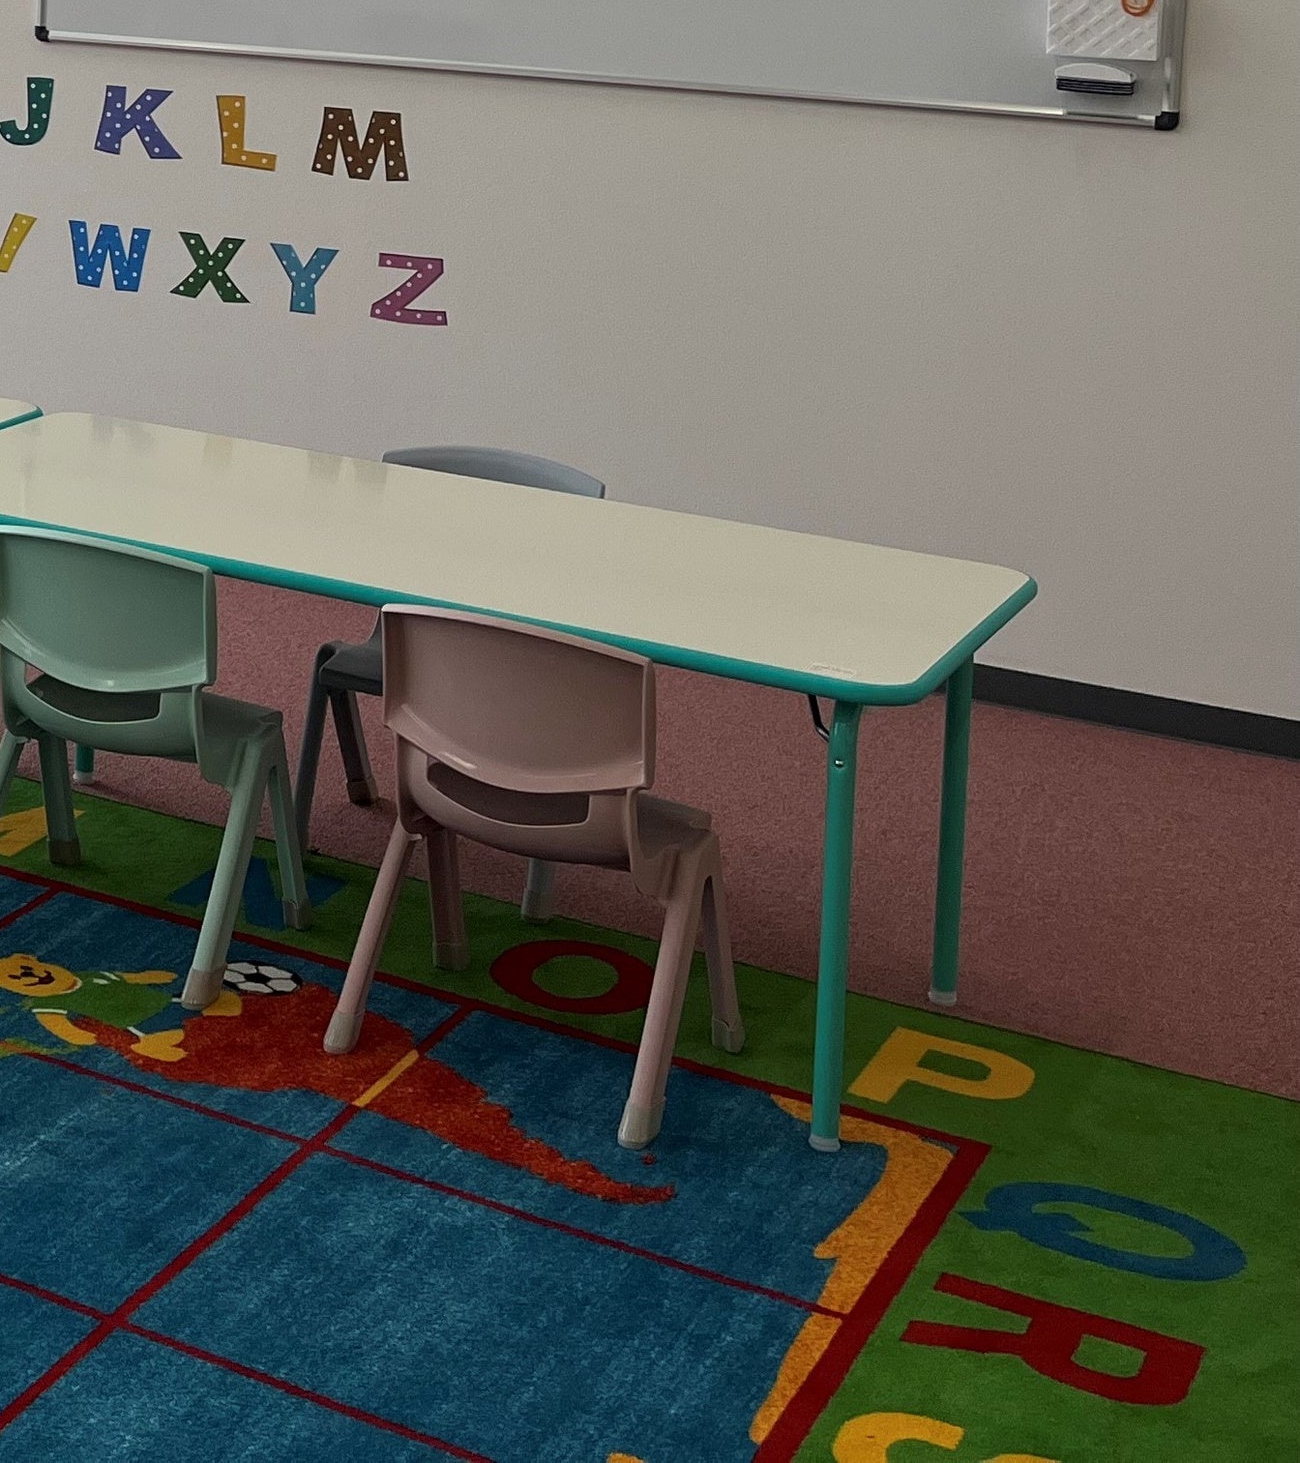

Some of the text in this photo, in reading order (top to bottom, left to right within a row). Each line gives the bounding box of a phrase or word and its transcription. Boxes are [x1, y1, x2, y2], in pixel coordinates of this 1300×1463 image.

[489, 940, 654, 1015] O
[848, 1026, 1036, 1104] P
[957, 1181, 1249, 1282] Q
[900, 1271, 1208, 1406] R
